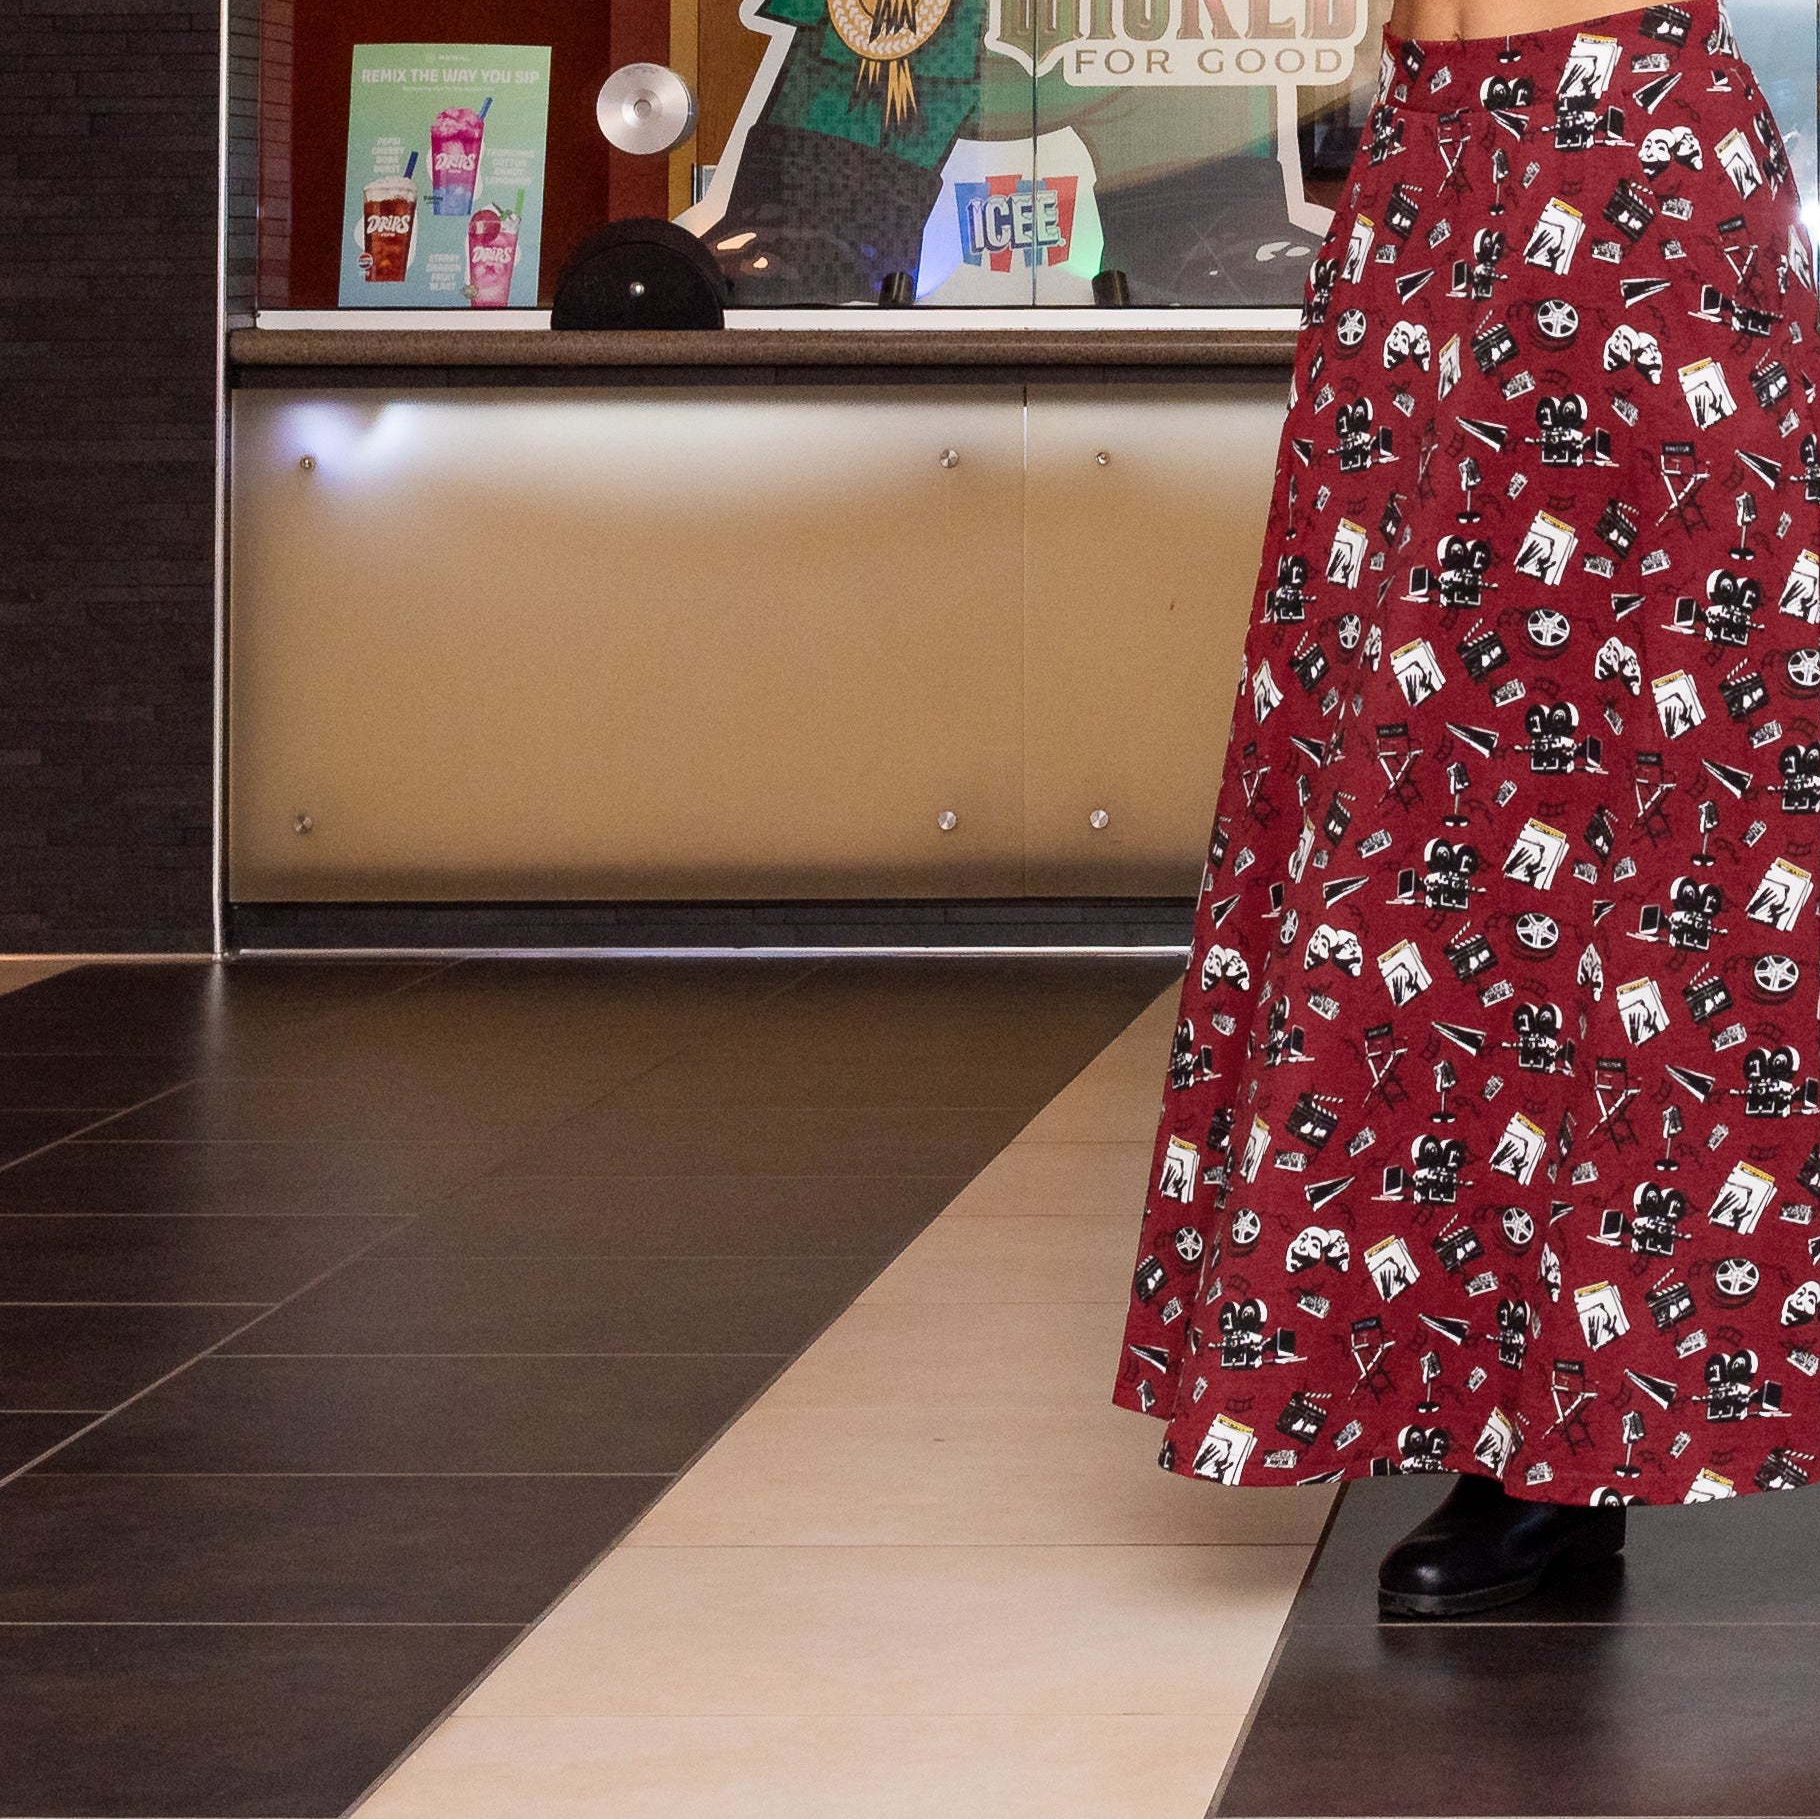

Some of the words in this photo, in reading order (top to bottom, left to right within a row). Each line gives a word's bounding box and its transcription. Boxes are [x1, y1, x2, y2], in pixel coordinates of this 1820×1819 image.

[1074, 48, 1173, 74] FOR
[1197, 48, 1343, 75] GOOD
[361, 68, 407, 83] REMIX
[411, 68, 439, 83] THE
[442, 69, 478, 83] WAY
[481, 69, 511, 84] YOU
[514, 70, 540, 85] SIP
[967, 189, 1060, 253] ICEE
